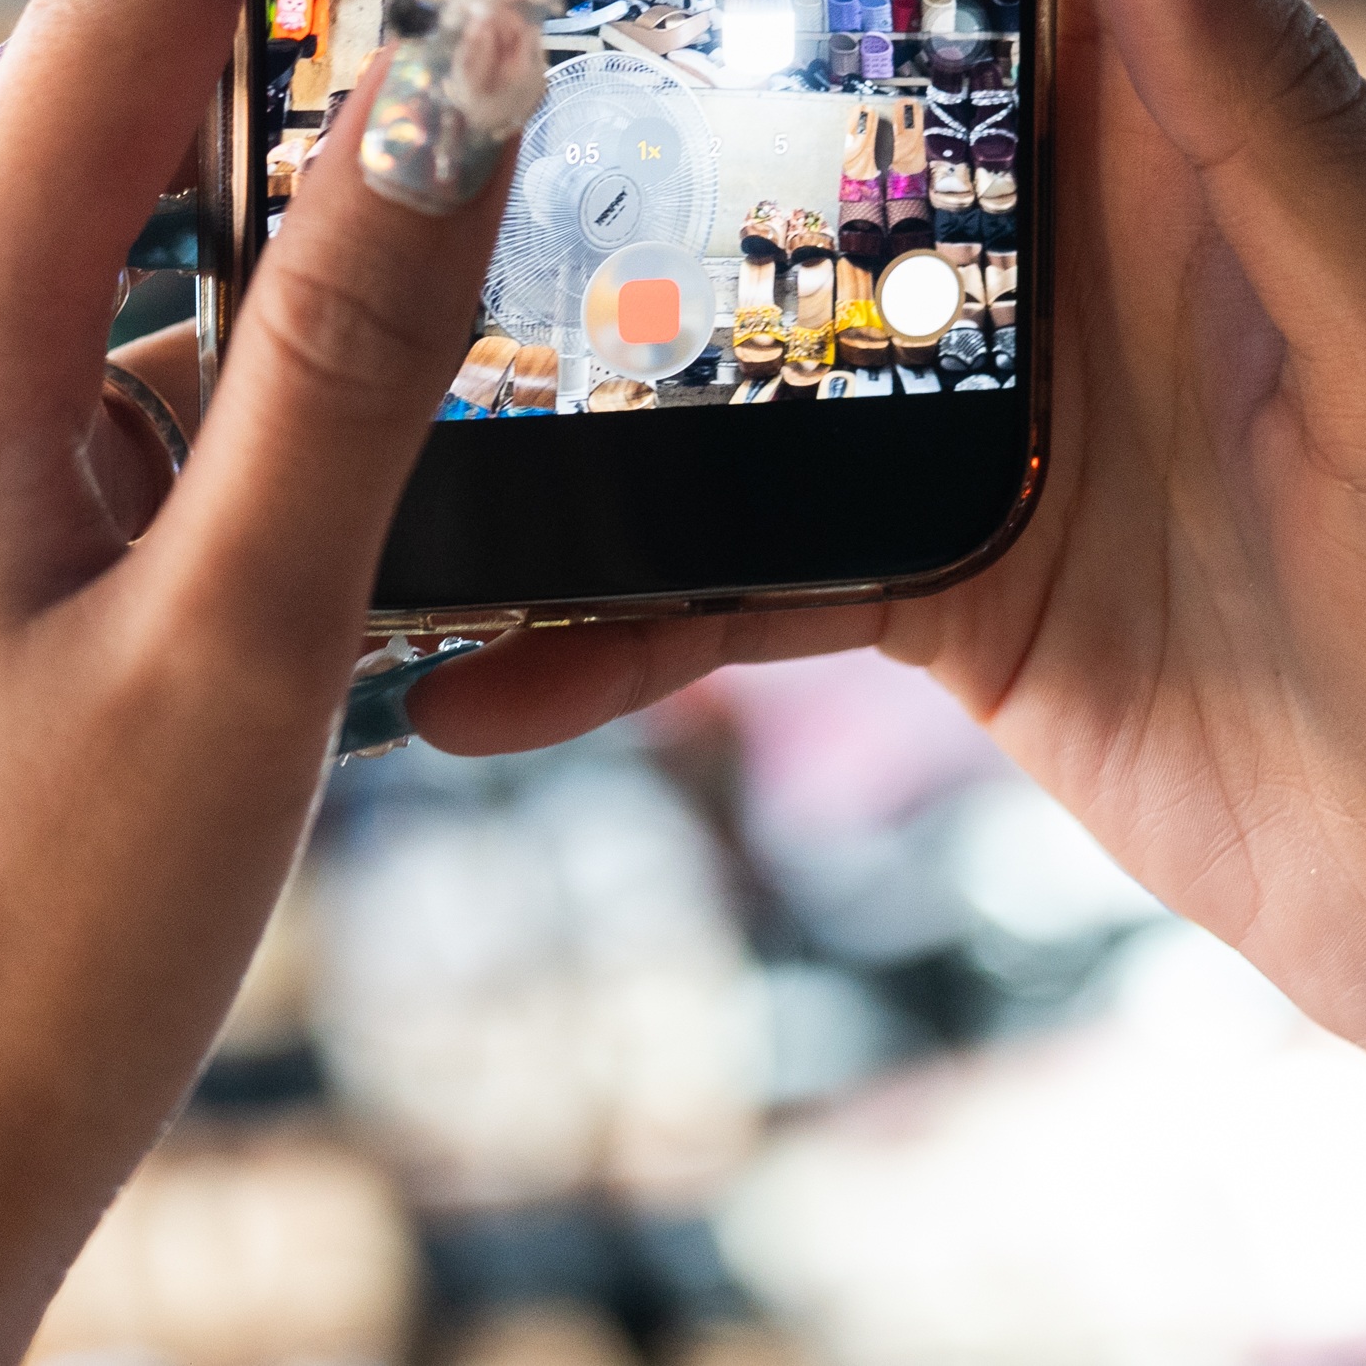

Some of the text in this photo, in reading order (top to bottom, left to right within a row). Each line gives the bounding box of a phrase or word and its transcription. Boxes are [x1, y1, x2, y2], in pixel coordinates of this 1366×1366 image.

[565, 134, 789, 166] 0,5 1x 2 5
